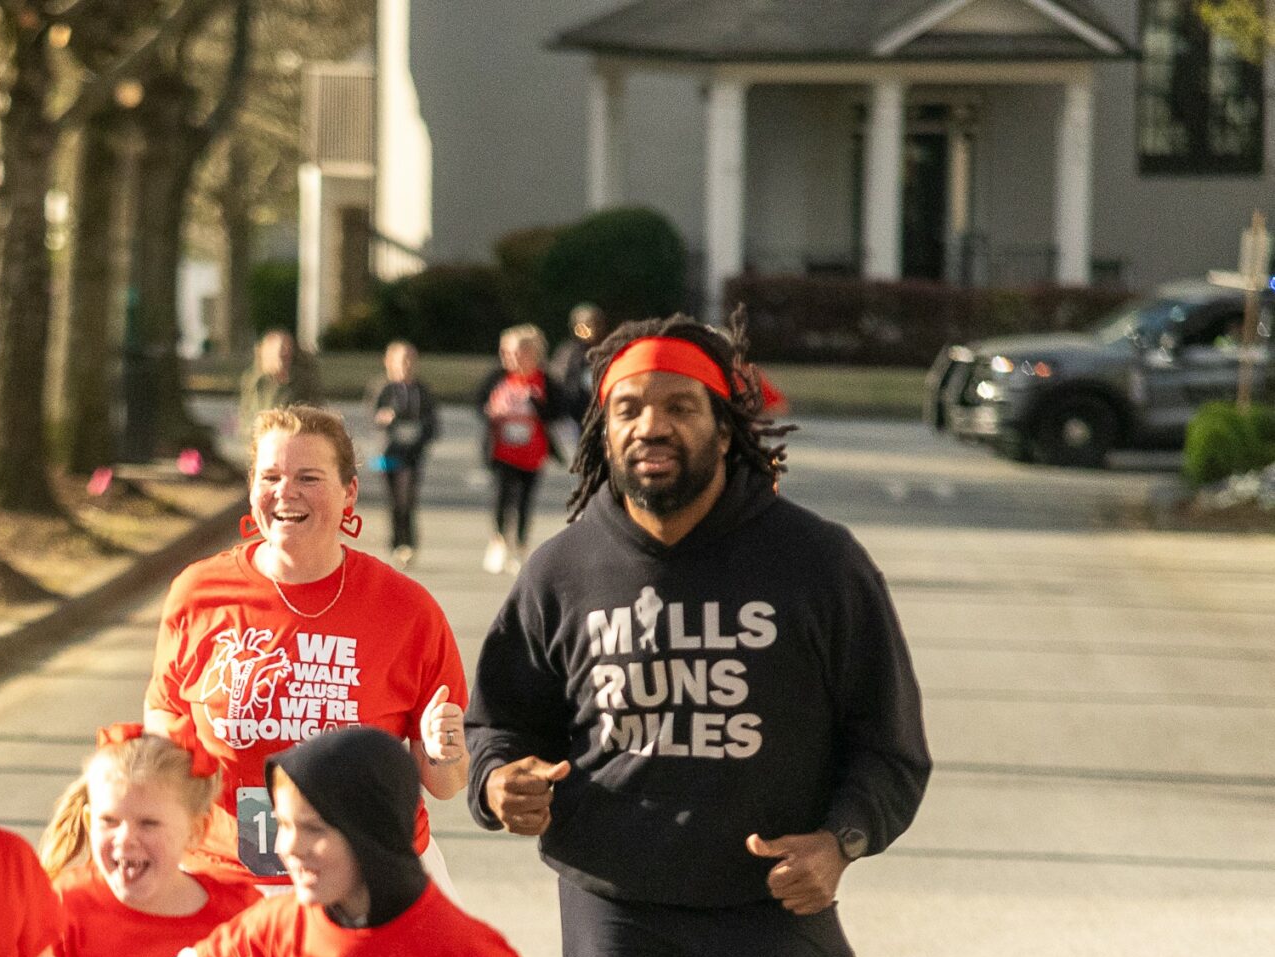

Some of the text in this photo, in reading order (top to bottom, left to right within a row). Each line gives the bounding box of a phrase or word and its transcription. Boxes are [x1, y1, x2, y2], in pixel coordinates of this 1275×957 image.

[297, 633, 357, 667] WE
[292, 662, 361, 686] WALK
[592, 659, 749, 710] RUNS
[279, 697, 359, 721] WE'RE
[214, 717, 322, 741] STRONG
[600, 712, 763, 759] MILES
